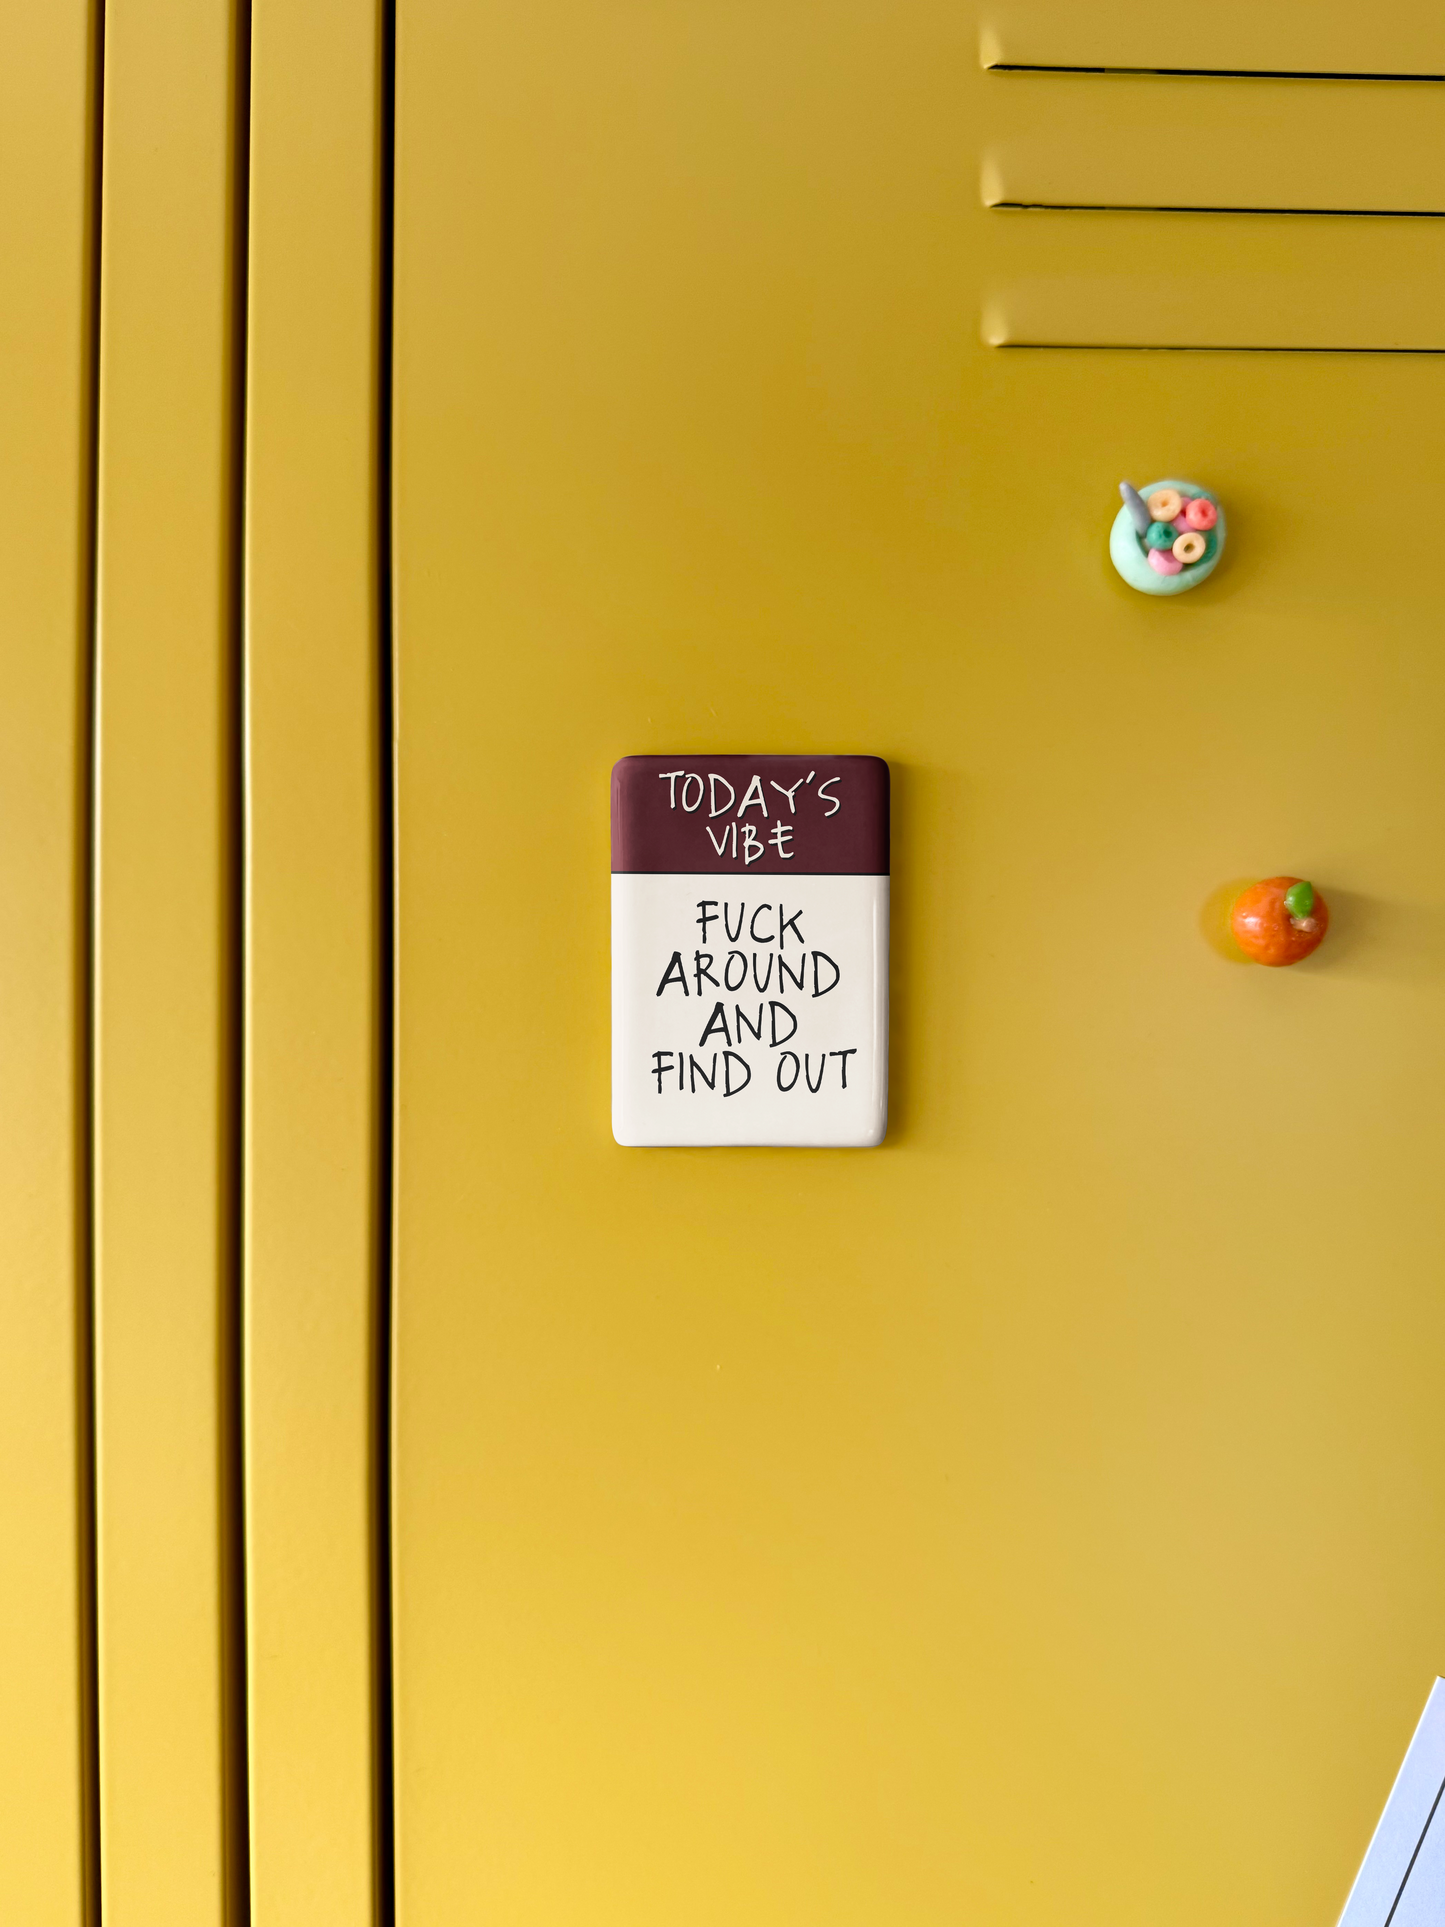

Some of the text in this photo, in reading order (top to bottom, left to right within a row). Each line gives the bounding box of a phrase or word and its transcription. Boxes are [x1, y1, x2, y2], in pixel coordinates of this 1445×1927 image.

[659, 770, 841, 818] TODAY'S
[706, 820, 795, 866] VIBE
[696, 900, 805, 949] FUCK
[656, 950, 840, 998] AROUND
[699, 1001, 798, 1048] AND
[652, 1048, 858, 1097] FIND OUT
